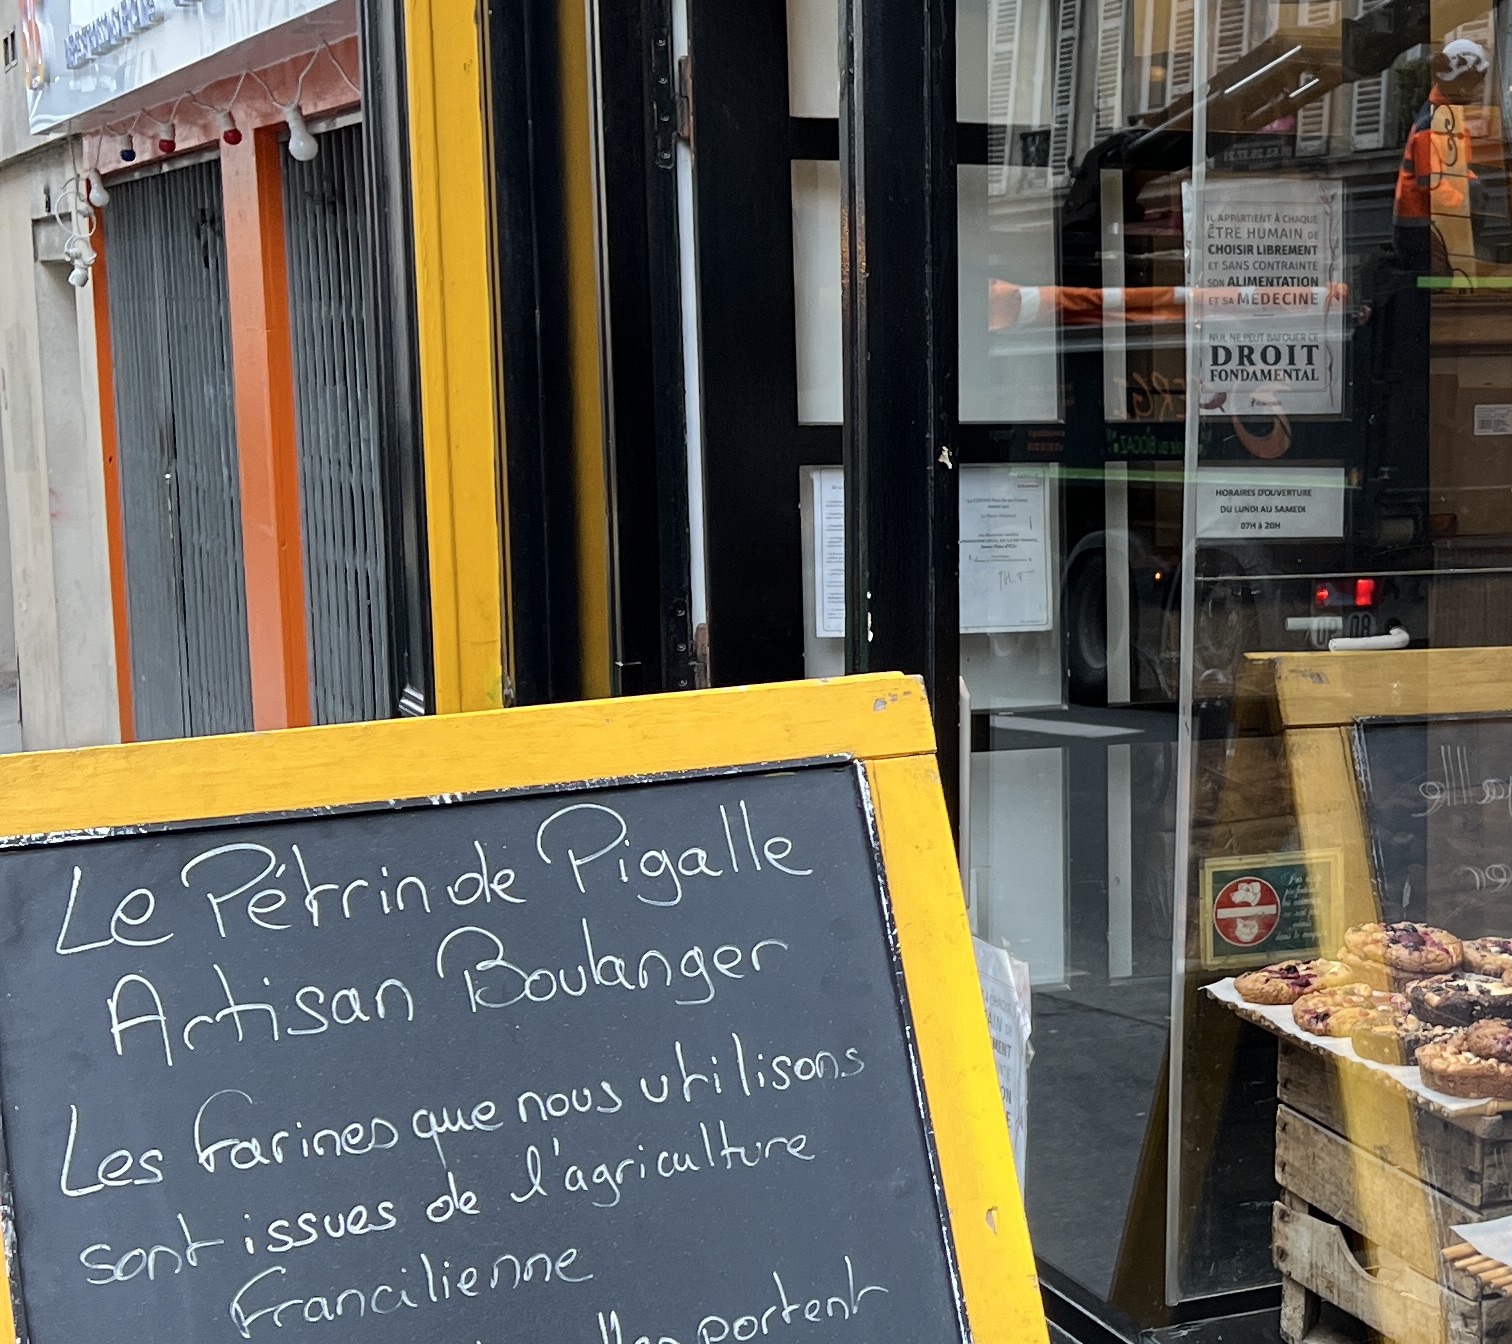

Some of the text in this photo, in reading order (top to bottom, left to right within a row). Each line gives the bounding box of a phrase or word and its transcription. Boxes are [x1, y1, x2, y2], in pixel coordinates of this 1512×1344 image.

[1206, 214, 1216, 223] IL
[1217, 214, 1272, 223] APPARTIENT
[1282, 214, 1319, 224] CHAQUE
[1207, 223, 1319, 240] ÊTRE HUMAIN DE
[1207, 244, 1318, 256] CHOISIR LIBREMENT
[1207, 260, 1319, 271] ET SANS CONTRAINTE
[1207, 276, 1319, 288] SON ALIMENTATION
[1208, 296, 1220, 306] ET
[1222, 296, 1235, 306] SA
[1208, 332, 1320, 343] NUL NE PEUT BAFOUER CE
[1209, 344, 1320, 367] DROIT
[1210, 368, 1320, 382] FONDAMENTAL
[1215, 488, 1313, 497] HORAIRES D'OUVERTURE
[1220, 505, 1306, 514] DU LUNDI AU SAMEDI
[1240, 521, 1256, 530] 07H
[1264, 521, 1281, 530] 20H
[54, 802, 813, 957] Le Pétrin de Pigalle
[107, 918, 790, 1068] Artisan Boulanger
[58, 1040, 867, 1199] Les farines que nous utilisons
[79, 1122, 815, 1287] sont issues de l'agriculture
